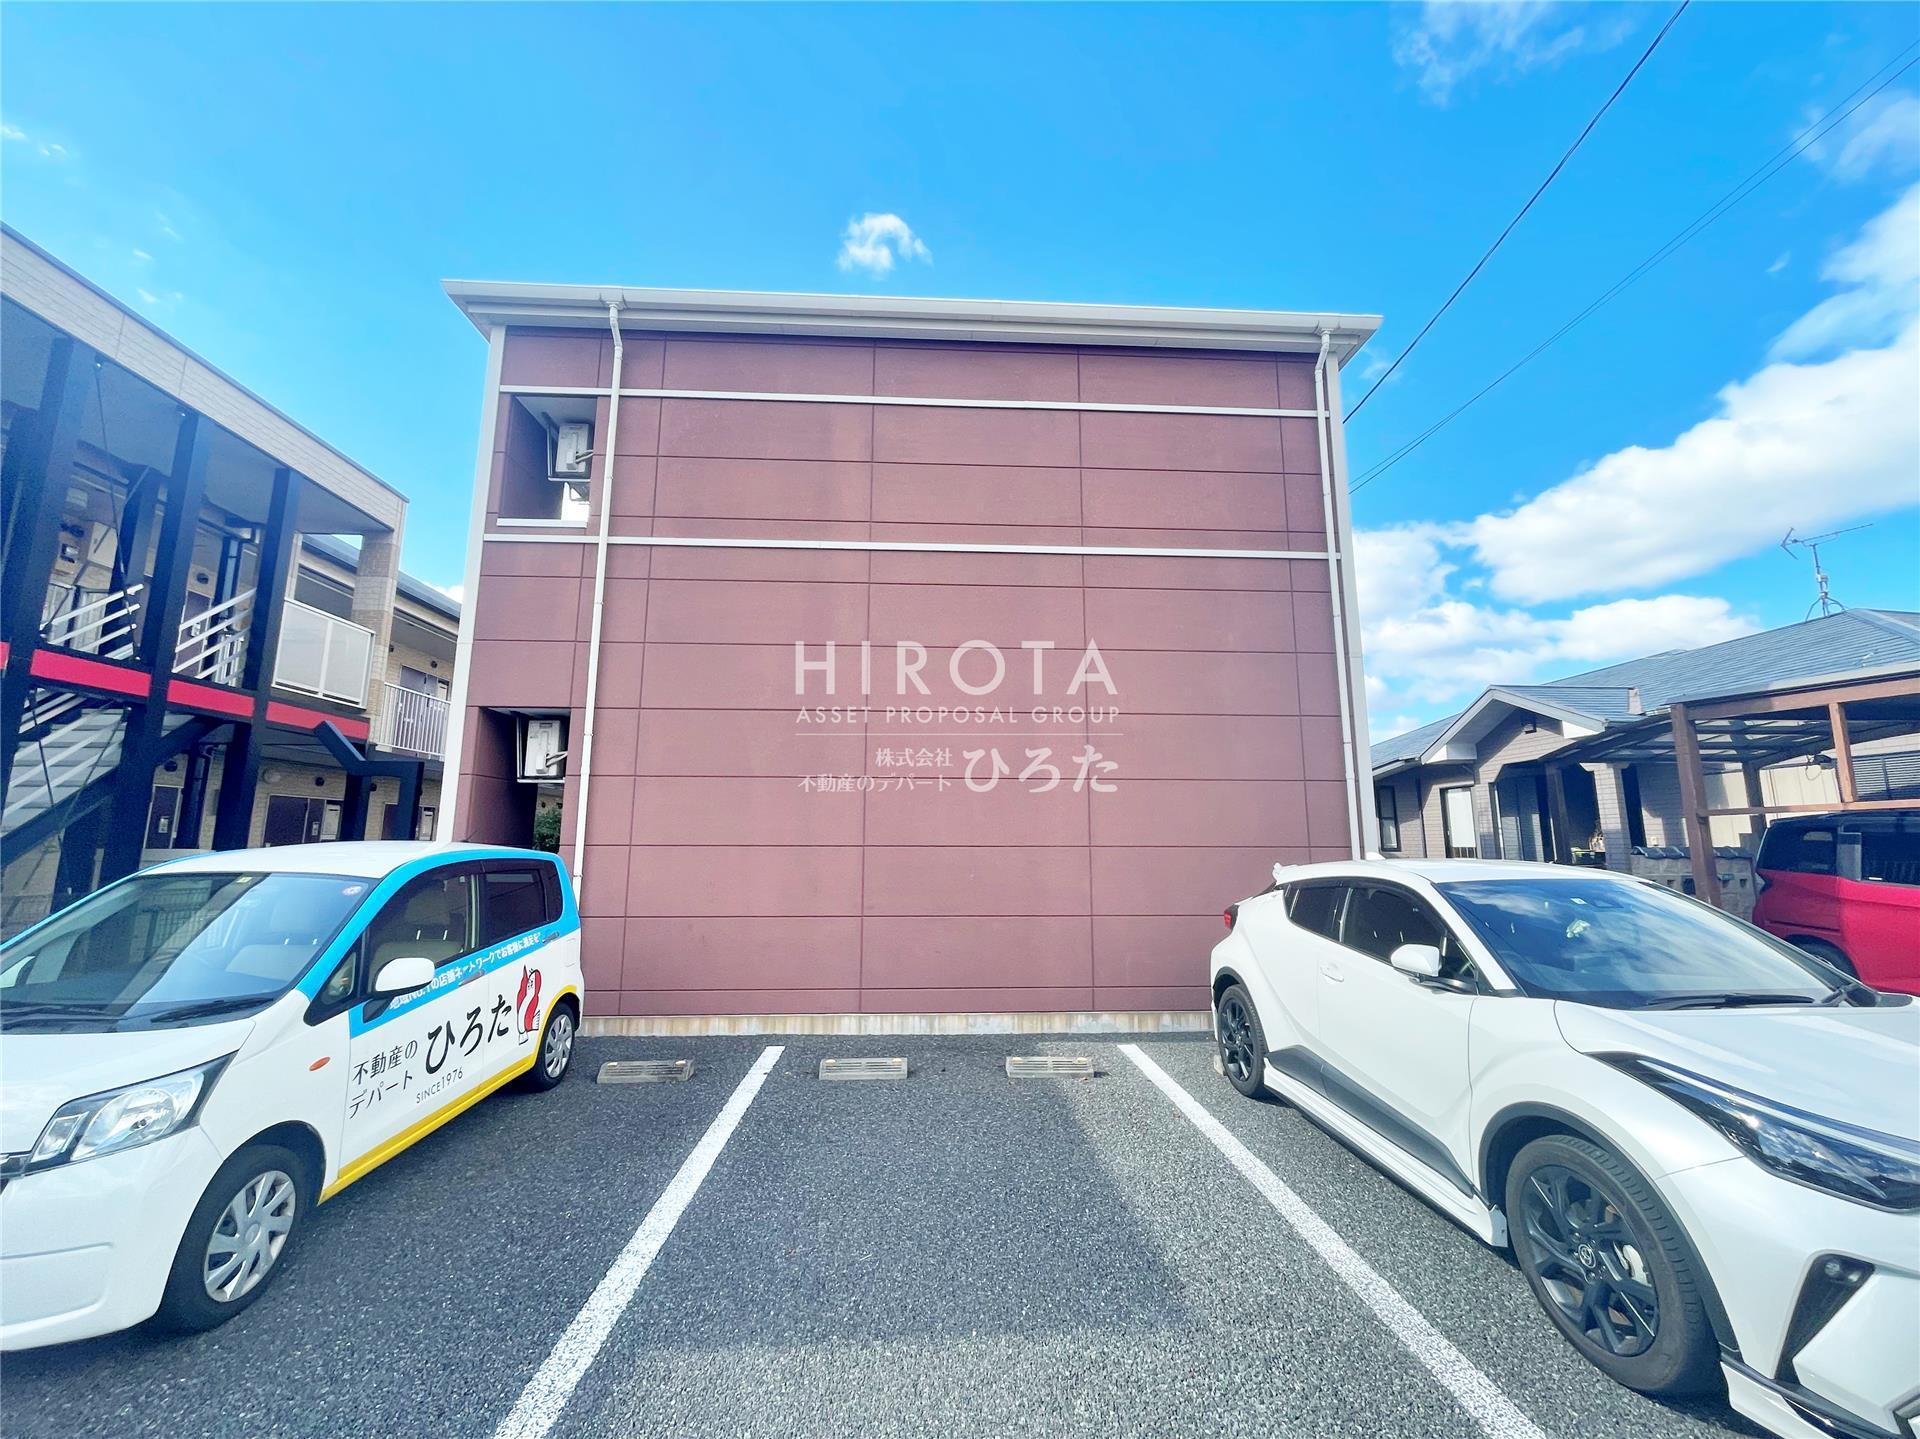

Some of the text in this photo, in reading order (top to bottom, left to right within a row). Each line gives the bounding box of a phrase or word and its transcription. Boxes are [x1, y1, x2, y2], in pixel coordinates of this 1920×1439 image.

[425, 994, 513, 1075] ひろた
[352, 1039, 418, 1086] 不動産の
[348, 1069, 413, 1120] デパート
